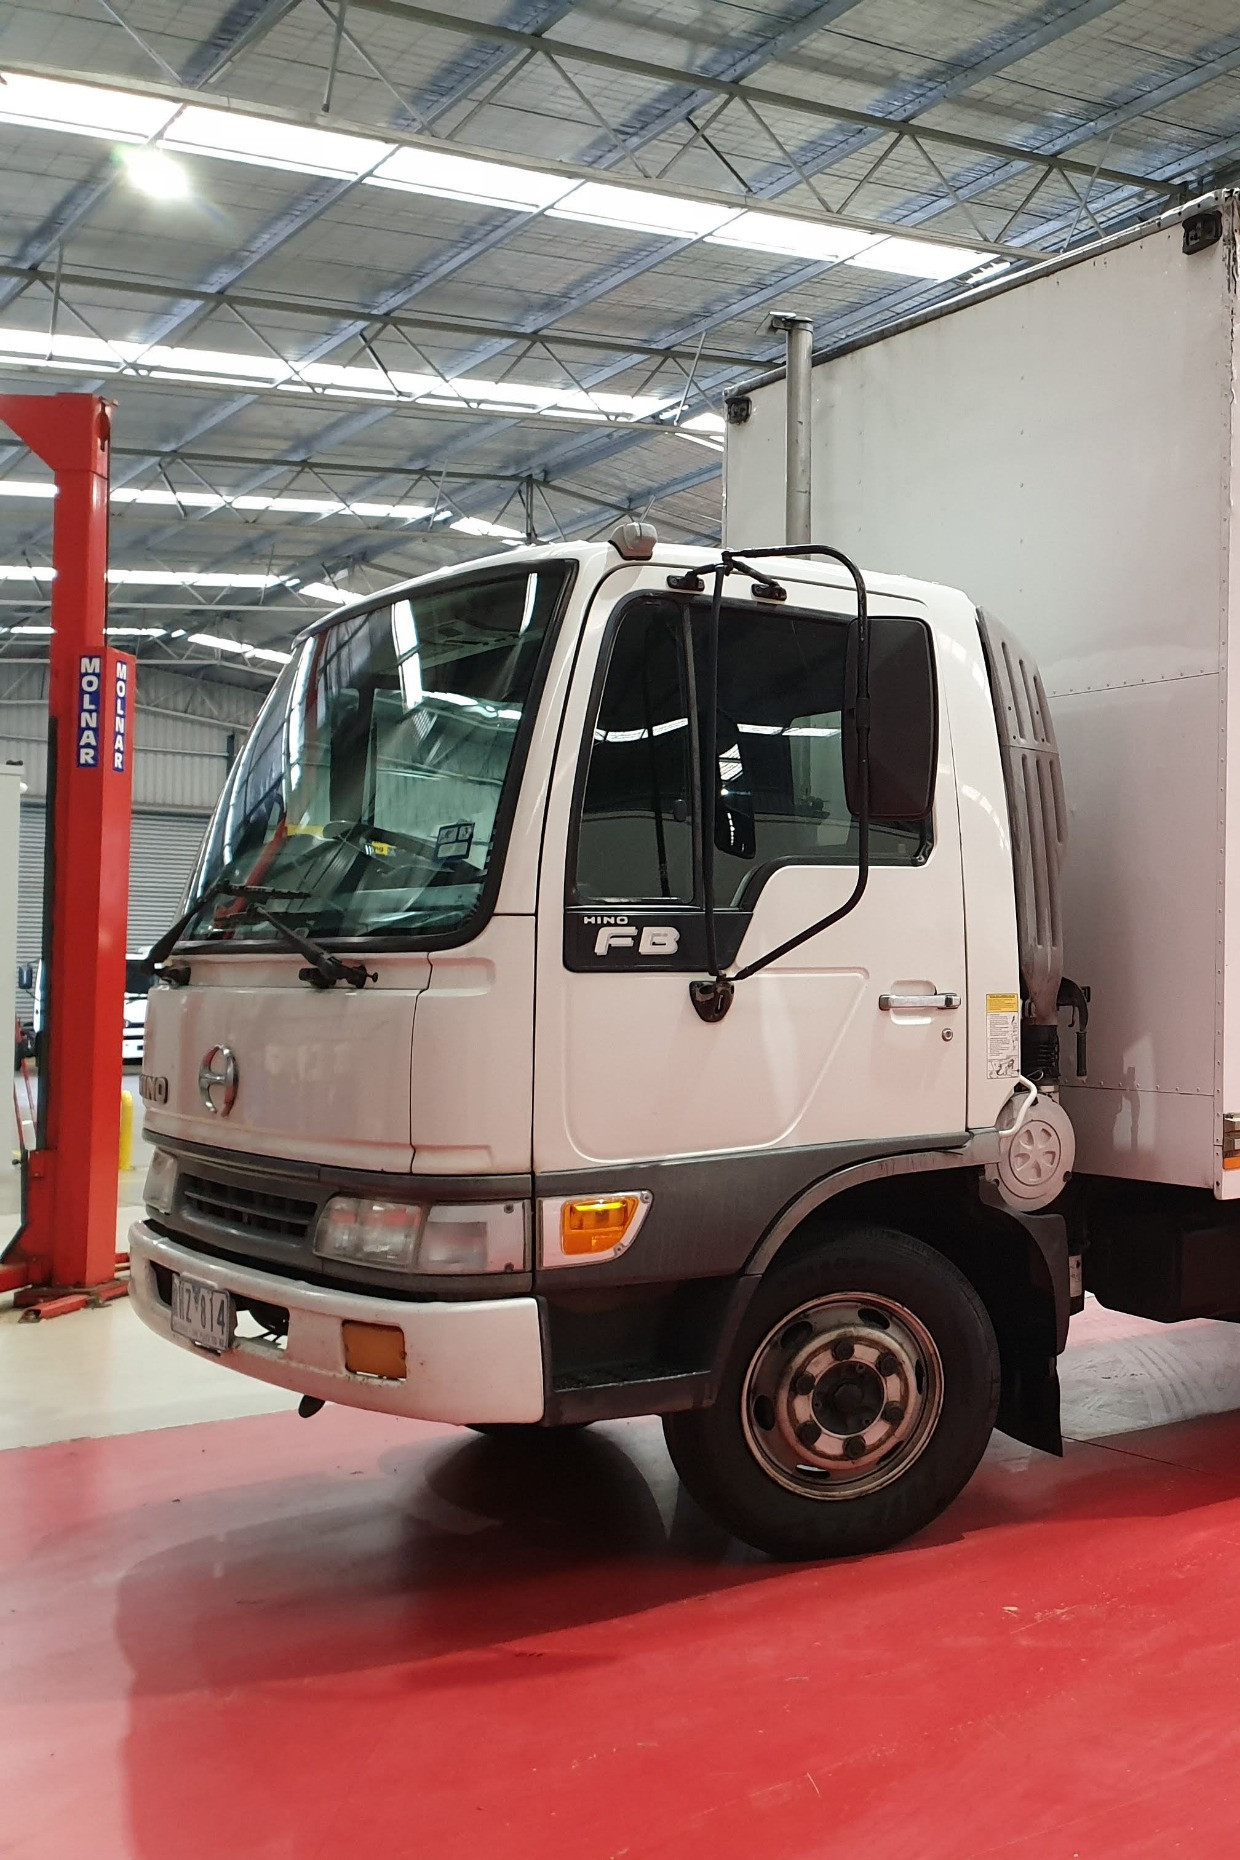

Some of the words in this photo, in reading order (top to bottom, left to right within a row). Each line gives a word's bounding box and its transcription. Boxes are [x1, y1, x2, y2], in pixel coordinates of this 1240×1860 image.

[79, 657, 100, 765] MOLNAR
[114, 661, 127, 769] MOLNAR
[583, 916, 629, 925] HINO
[594, 926, 681, 956] FB
